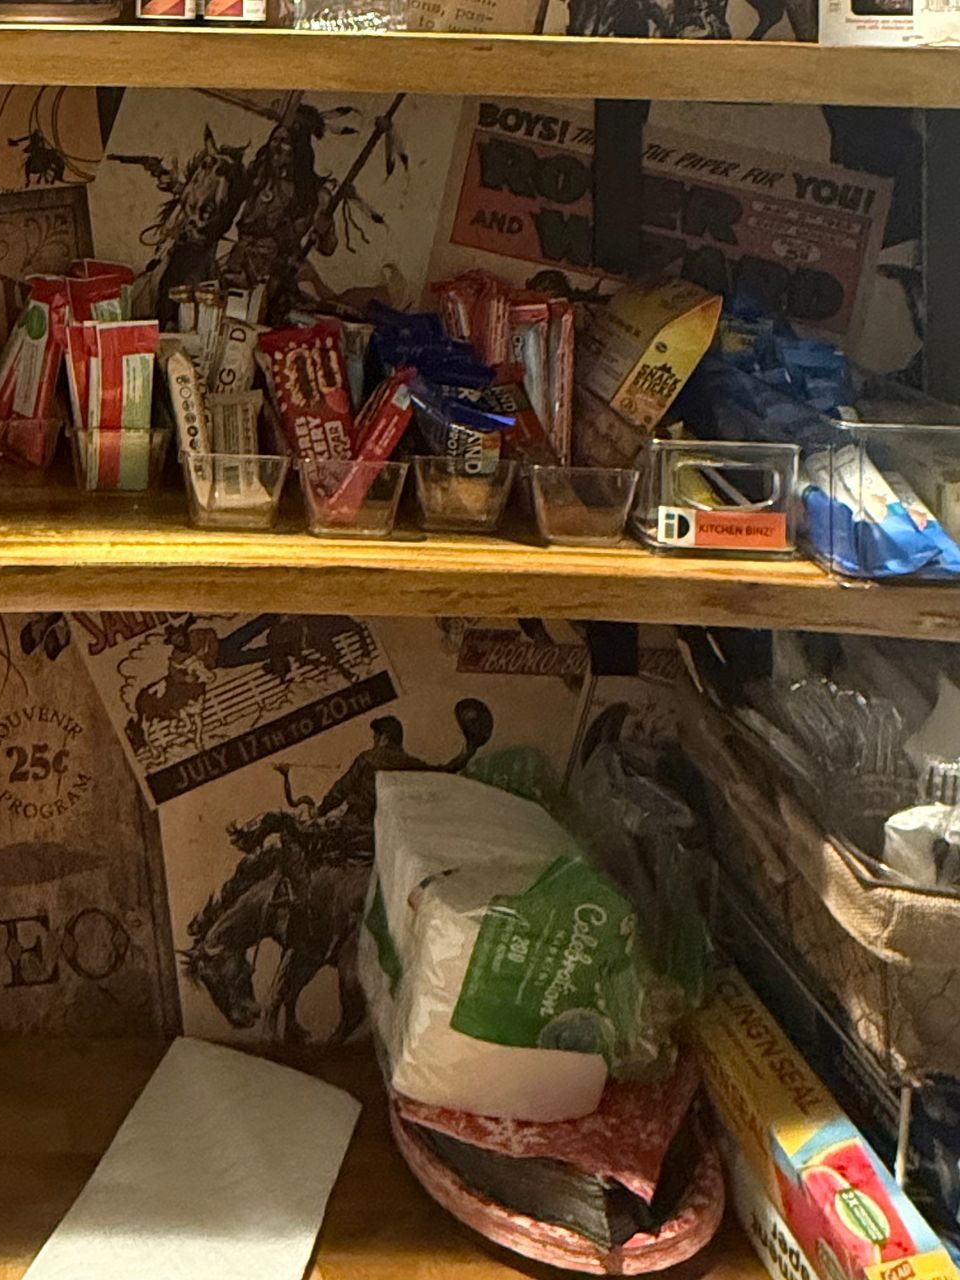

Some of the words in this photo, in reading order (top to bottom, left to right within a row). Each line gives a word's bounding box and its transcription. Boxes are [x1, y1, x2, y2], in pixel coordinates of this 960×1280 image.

[477, 102, 570, 144] BOYS!
[641, 143, 676, 164] THE
[675, 152, 740, 178] PAPER
[741, 167, 786, 188] FOR
[792, 172, 876, 216] YOU!
[469, 209, 524, 234] AND
[698, 523, 743, 535] KITCHEN
[486, 644, 560, 672] BRONCO
[176, 745, 229, 789] JULY
[238, 732, 287, 764] 17TH
[316, 691, 372, 725] 20TH
